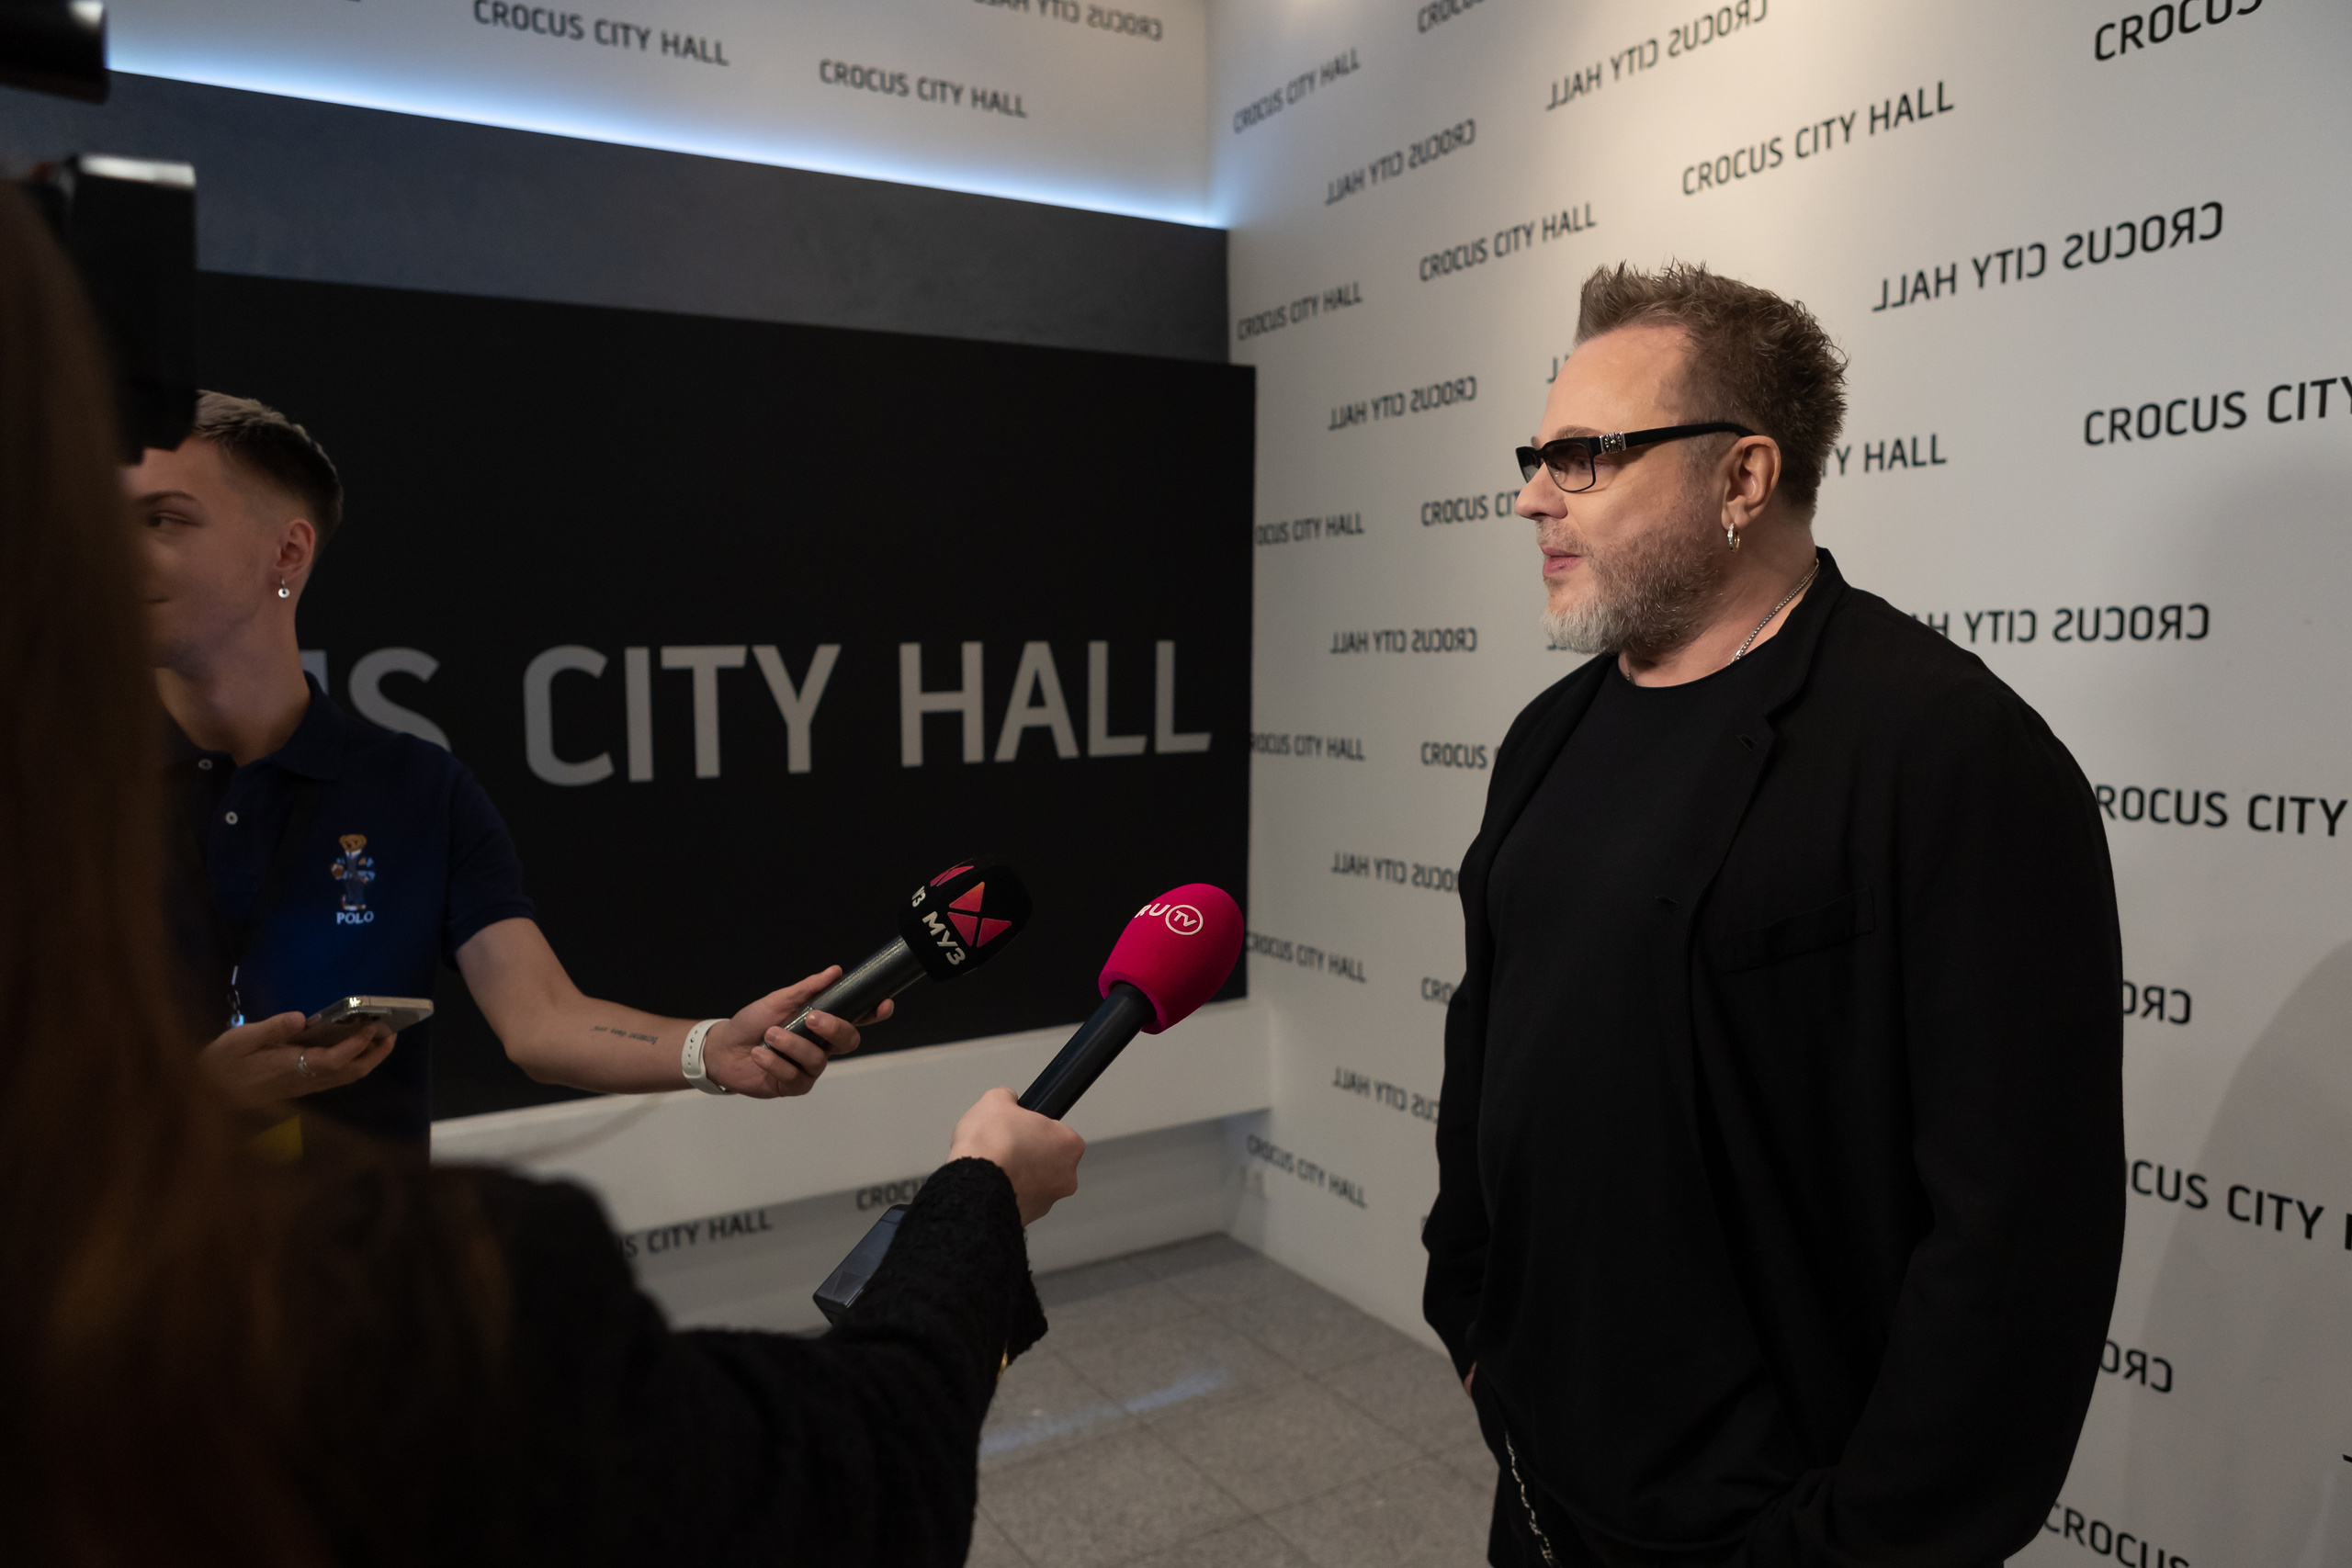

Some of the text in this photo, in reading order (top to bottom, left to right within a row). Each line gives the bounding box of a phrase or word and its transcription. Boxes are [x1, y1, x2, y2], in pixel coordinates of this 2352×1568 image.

[473, 0, 730, 66] CROCUS CITY HALL
[820, 59, 1028, 118] CROCUS CITY HALL
[1233, 47, 1361, 135] CROCUS CITY HALL
[1683, 81, 1955, 196] CROCUS CITY HALL
[1419, 202, 1598, 282] CROCUS CITY HALL
[1237, 281, 1363, 341] CROCUS CITY HALL
[2084, 390, 2247, 446] CROCUS
[1863, 433, 1948, 474] HALL
[1292, 517, 1323, 543] CITY
[1326, 512, 1365, 536] HALL
[1420, 494, 1489, 527] CROCUS
[523, 644, 842, 787] CITY
[899, 640, 1213, 768] HALL
[1294, 734, 1322, 758] CITY
[1326, 737, 1366, 762] HALL
[1420, 741, 1488, 770] CROCUS
[2095, 784, 2349, 838] ROCUS CITY
[335, 910, 375, 925] POLO
[1296, 943, 1325, 971] CITY
[1328, 953, 1367, 984] HALL
[1246, 1133, 1368, 1210] CROCUS CITY HALL
[646, 1223, 700, 1255] CITY
[707, 1208, 774, 1242] HALL
[2227, 1184, 2325, 1241] CITY
